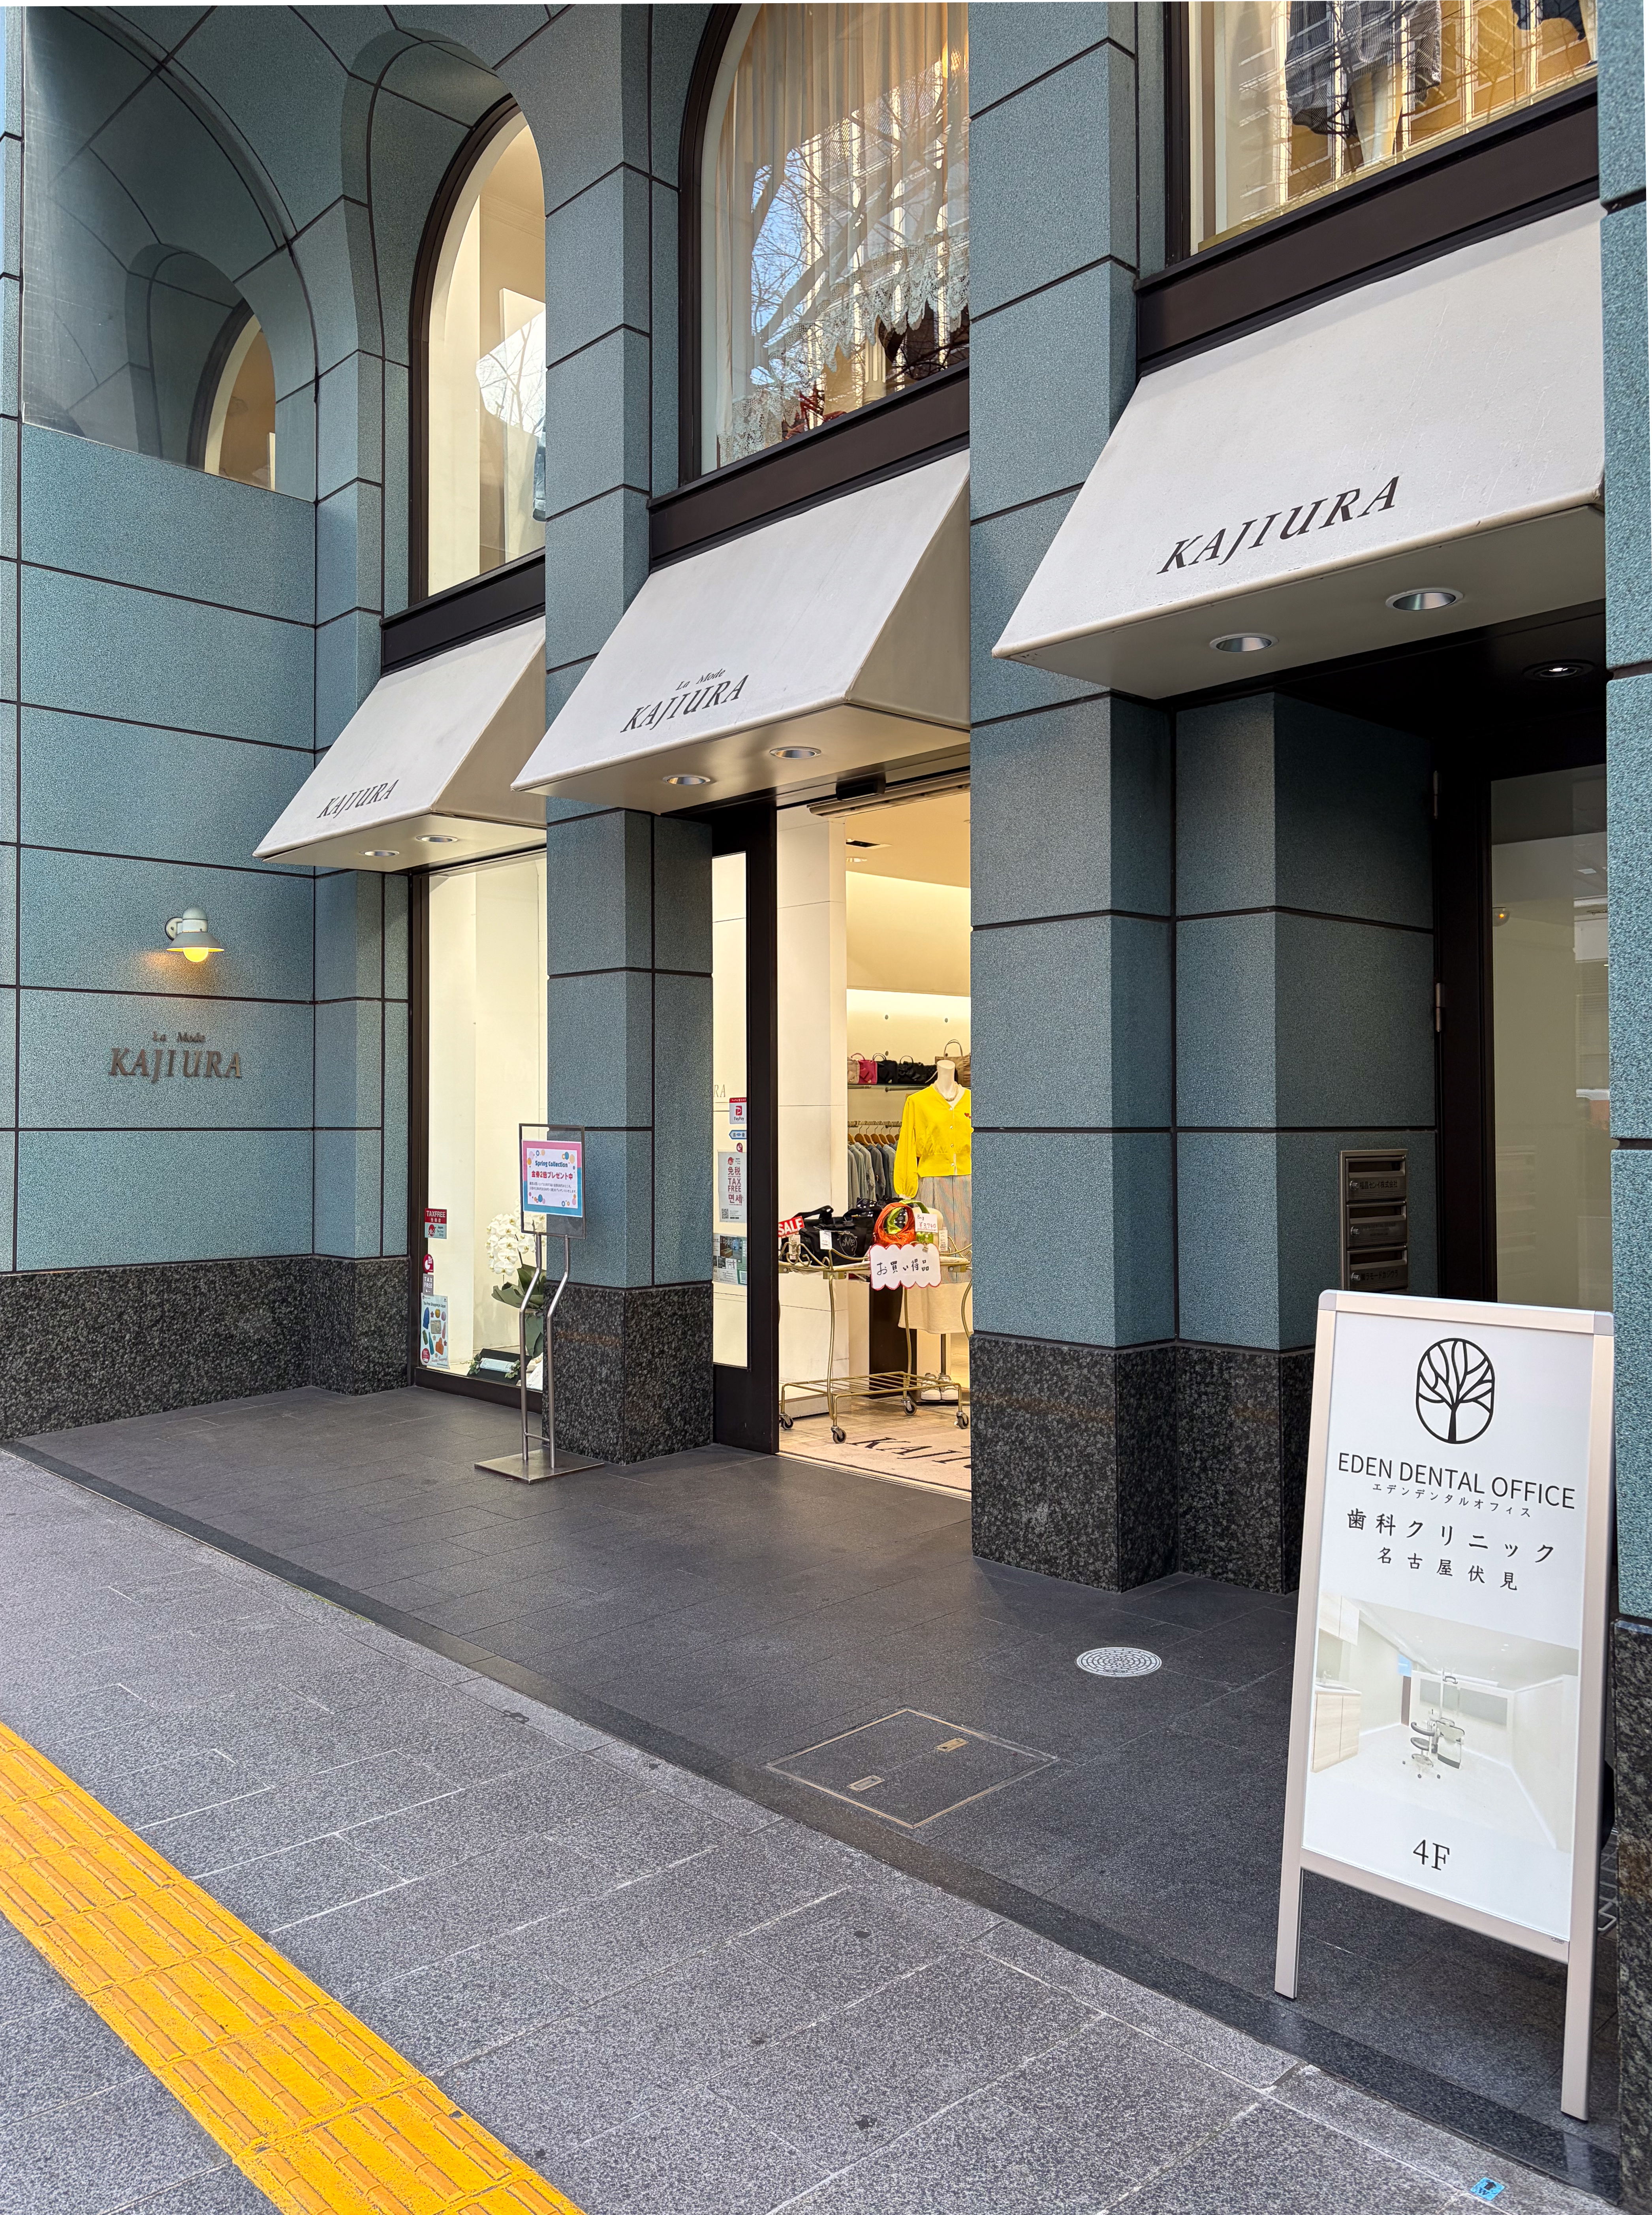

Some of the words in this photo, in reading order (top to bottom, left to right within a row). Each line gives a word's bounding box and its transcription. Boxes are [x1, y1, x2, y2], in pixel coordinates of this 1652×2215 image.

[1156, 476, 1399, 574] KAJIURA
[675, 681, 690, 690] La
[696, 668, 725, 684] Mode
[620, 675, 749, 733] KAJIURA
[317, 779, 399, 818] KAJIURA
[153, 1030, 166, 1042] La
[178, 1032, 205, 1042] Mode
[109, 1048, 242, 1084] KAJIURA
[729, 1194, 742, 1204] 면세
[778, 1218, 802, 1235] SALE
[876, 1258, 929, 1275] お買い得品
[846, 1437, 971, 1469] KAJI
[1338, 1452, 1392, 1479] EDEN
[1399, 1461, 1485, 1494] DENTAL
[1491, 1476, 1575, 1510] OFFICE
[1372, 1483, 1531, 1517] エデンデンタルオフィス
[1347, 1508, 1554, 1563] 歯科クリニック
[1377, 1546, 1518, 1591] 名古屋伏見
[1412, 1839, 1451, 1871] 4F
